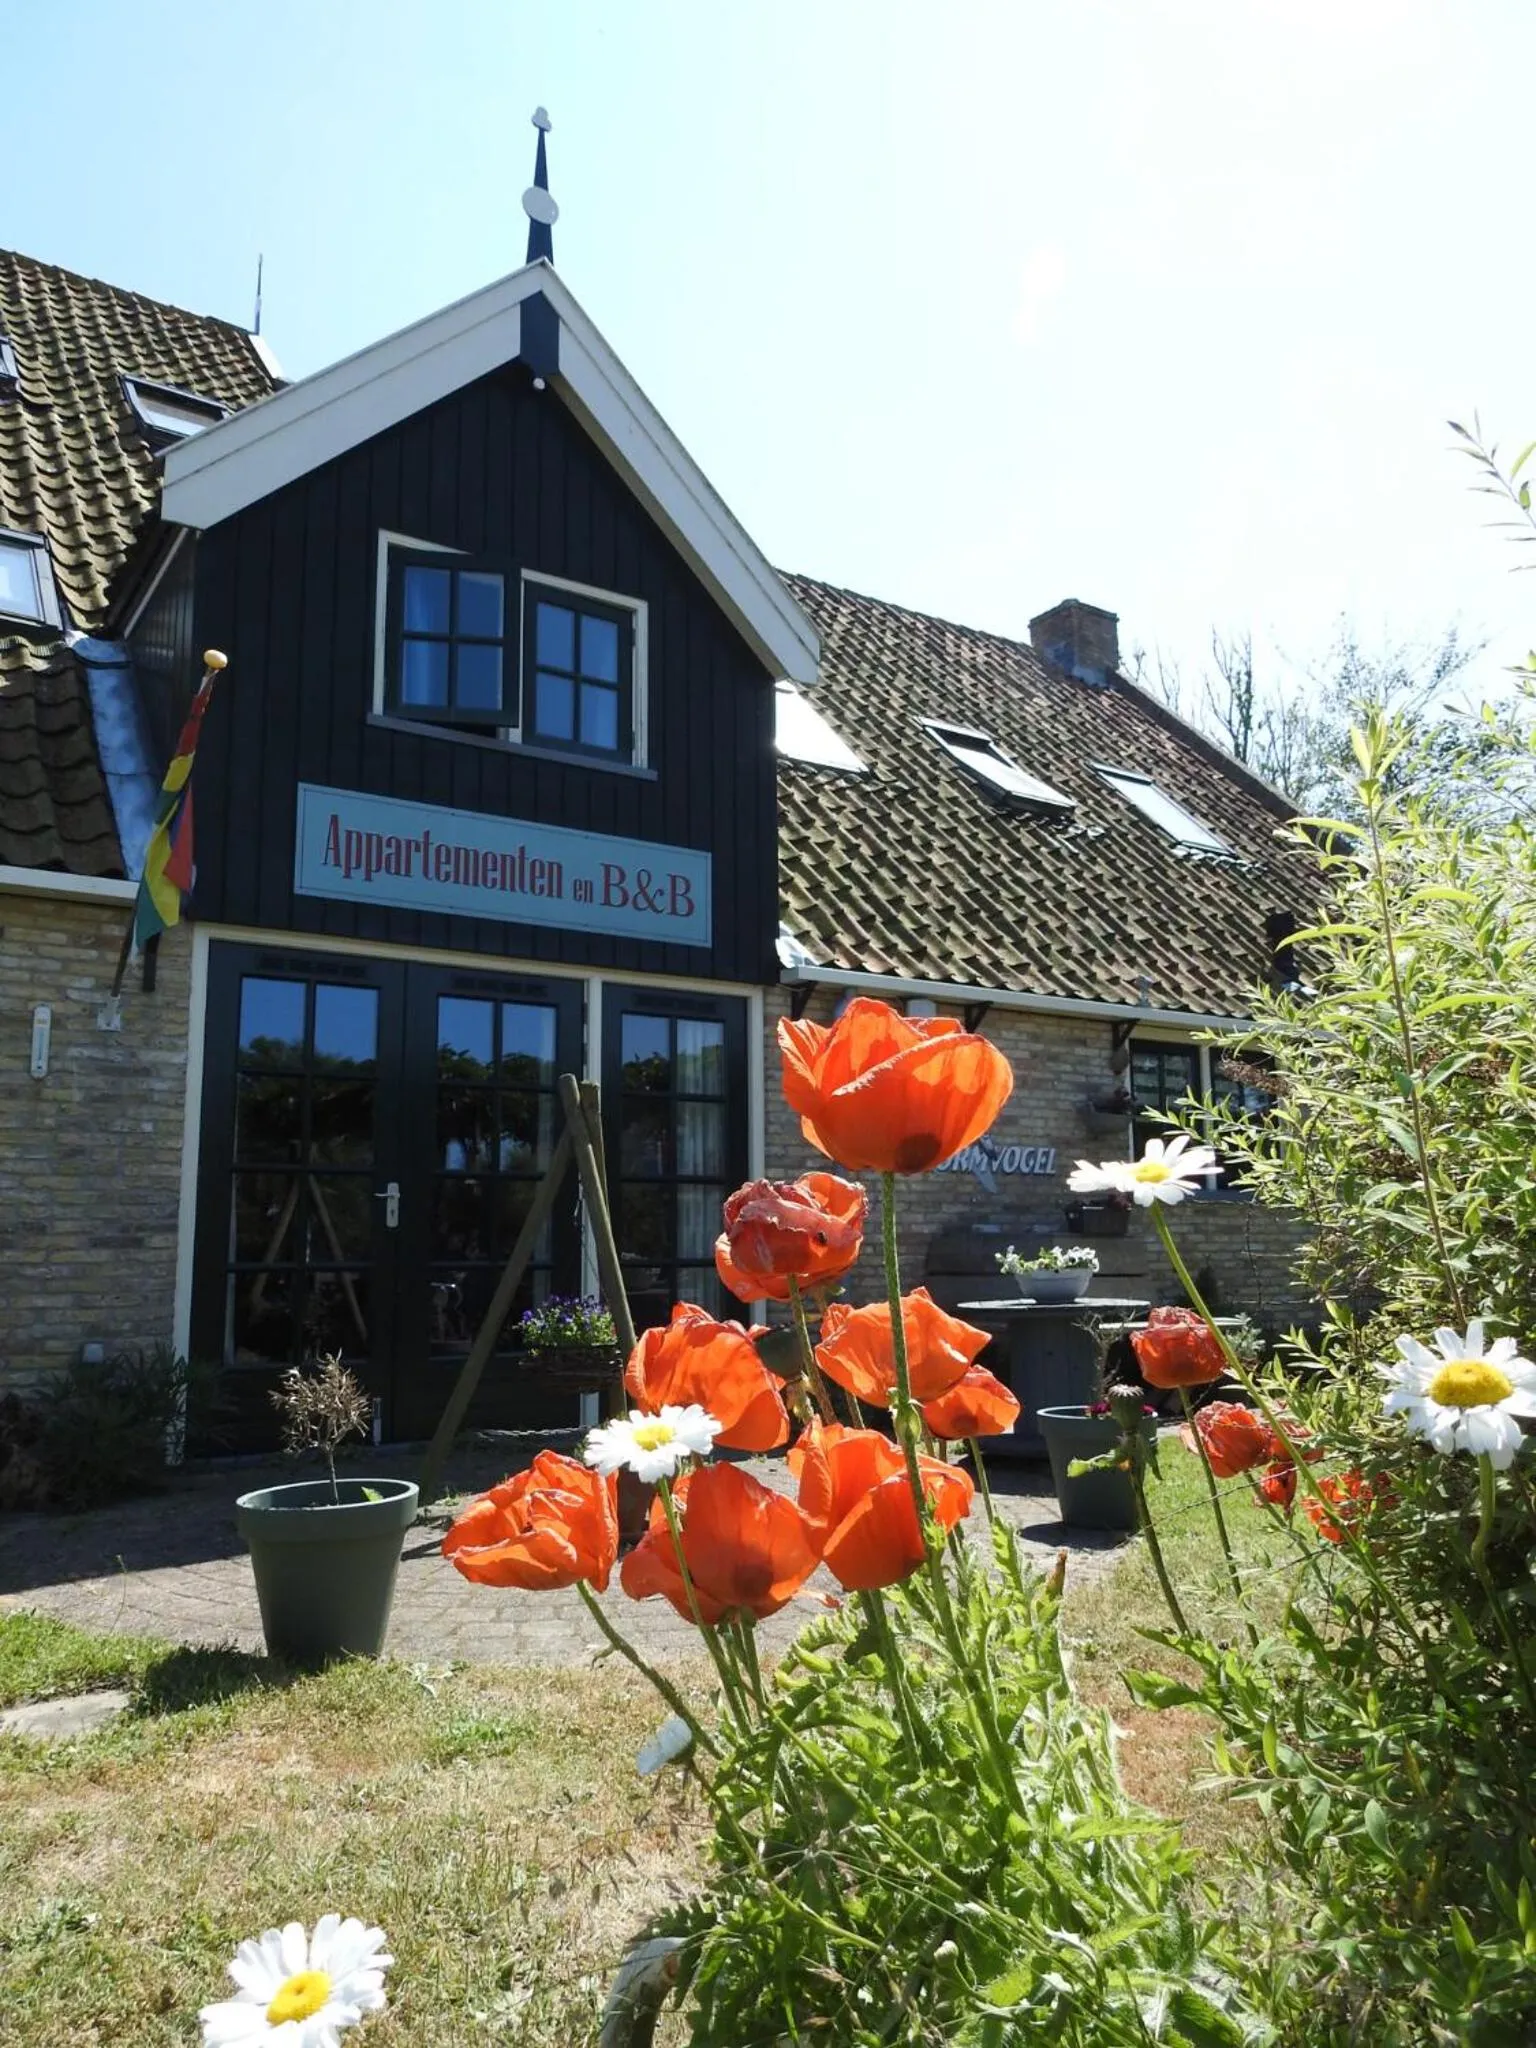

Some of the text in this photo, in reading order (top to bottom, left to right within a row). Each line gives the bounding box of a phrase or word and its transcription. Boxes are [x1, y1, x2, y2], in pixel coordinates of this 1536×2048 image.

[322, 813, 695, 918] Appartementen en B&B
